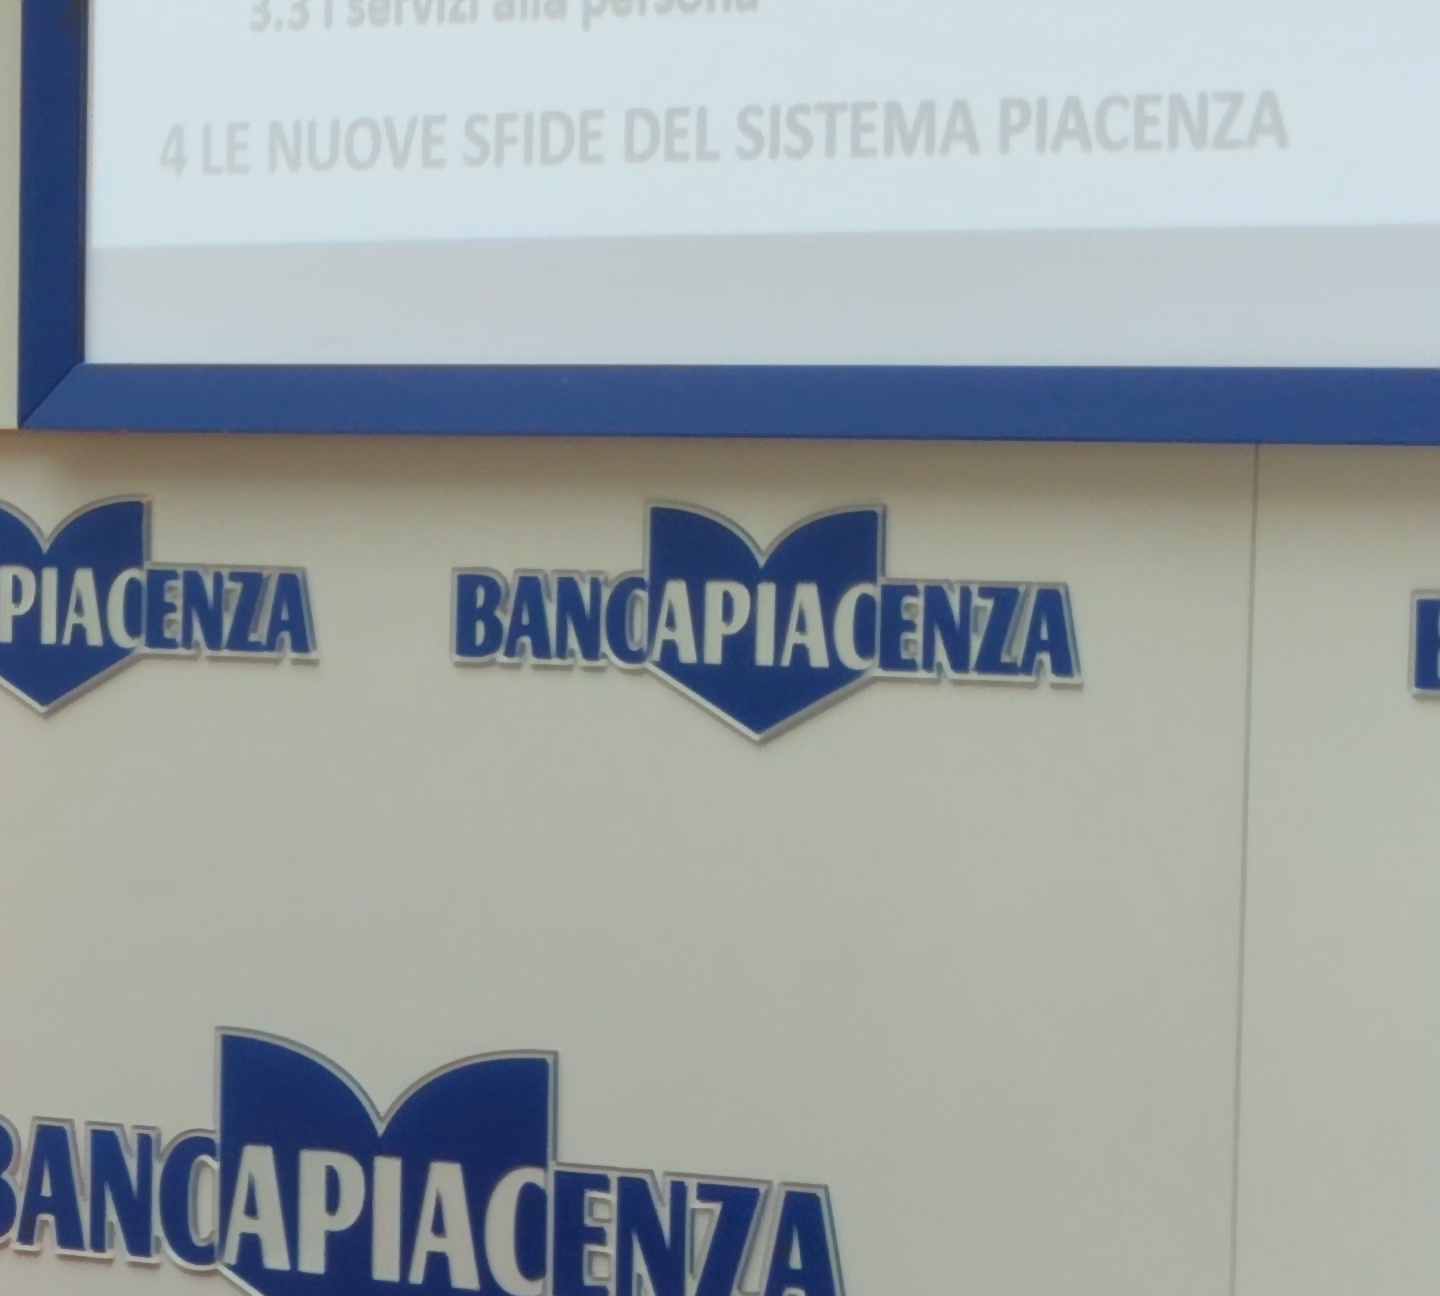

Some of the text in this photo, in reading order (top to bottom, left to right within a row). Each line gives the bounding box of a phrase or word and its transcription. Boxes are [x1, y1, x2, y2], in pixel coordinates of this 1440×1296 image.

[159, 89, 1290, 177] 4 LE NUOVE SFIDE DEL SISTEMA PIACENZA
[454, 572, 1076, 677] BANCAPIACENZA
